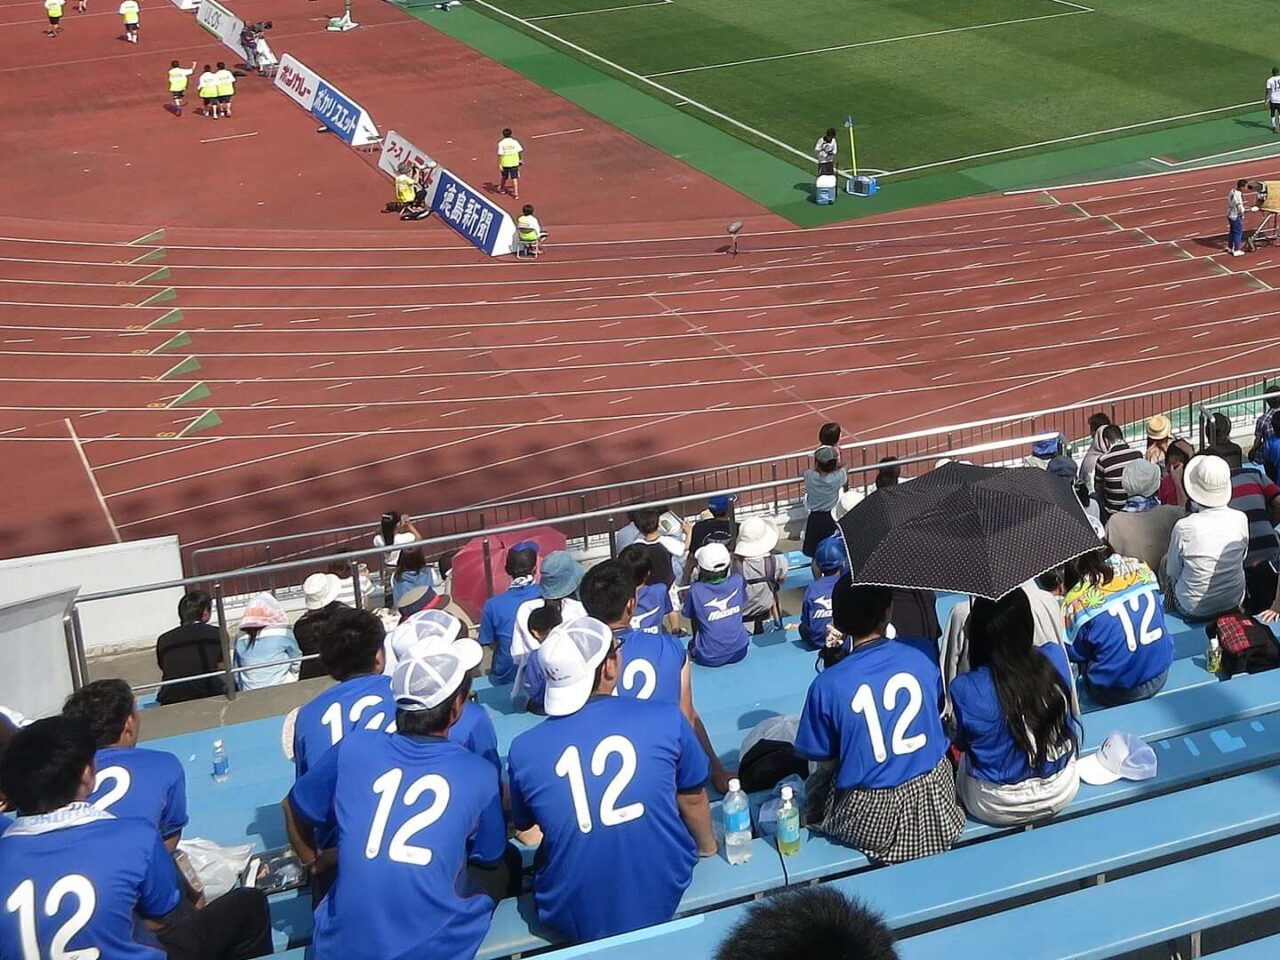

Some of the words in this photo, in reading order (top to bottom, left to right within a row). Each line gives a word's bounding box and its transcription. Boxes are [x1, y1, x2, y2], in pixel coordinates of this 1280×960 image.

[439, 183, 493, 245] 徳島新聞
[1109, 591, 1163, 653] 12
[851, 672, 927, 763] 12
[370, 767, 451, 866] 12
[555, 735, 645, 834] 12
[6, 873, 101, 960] 12
